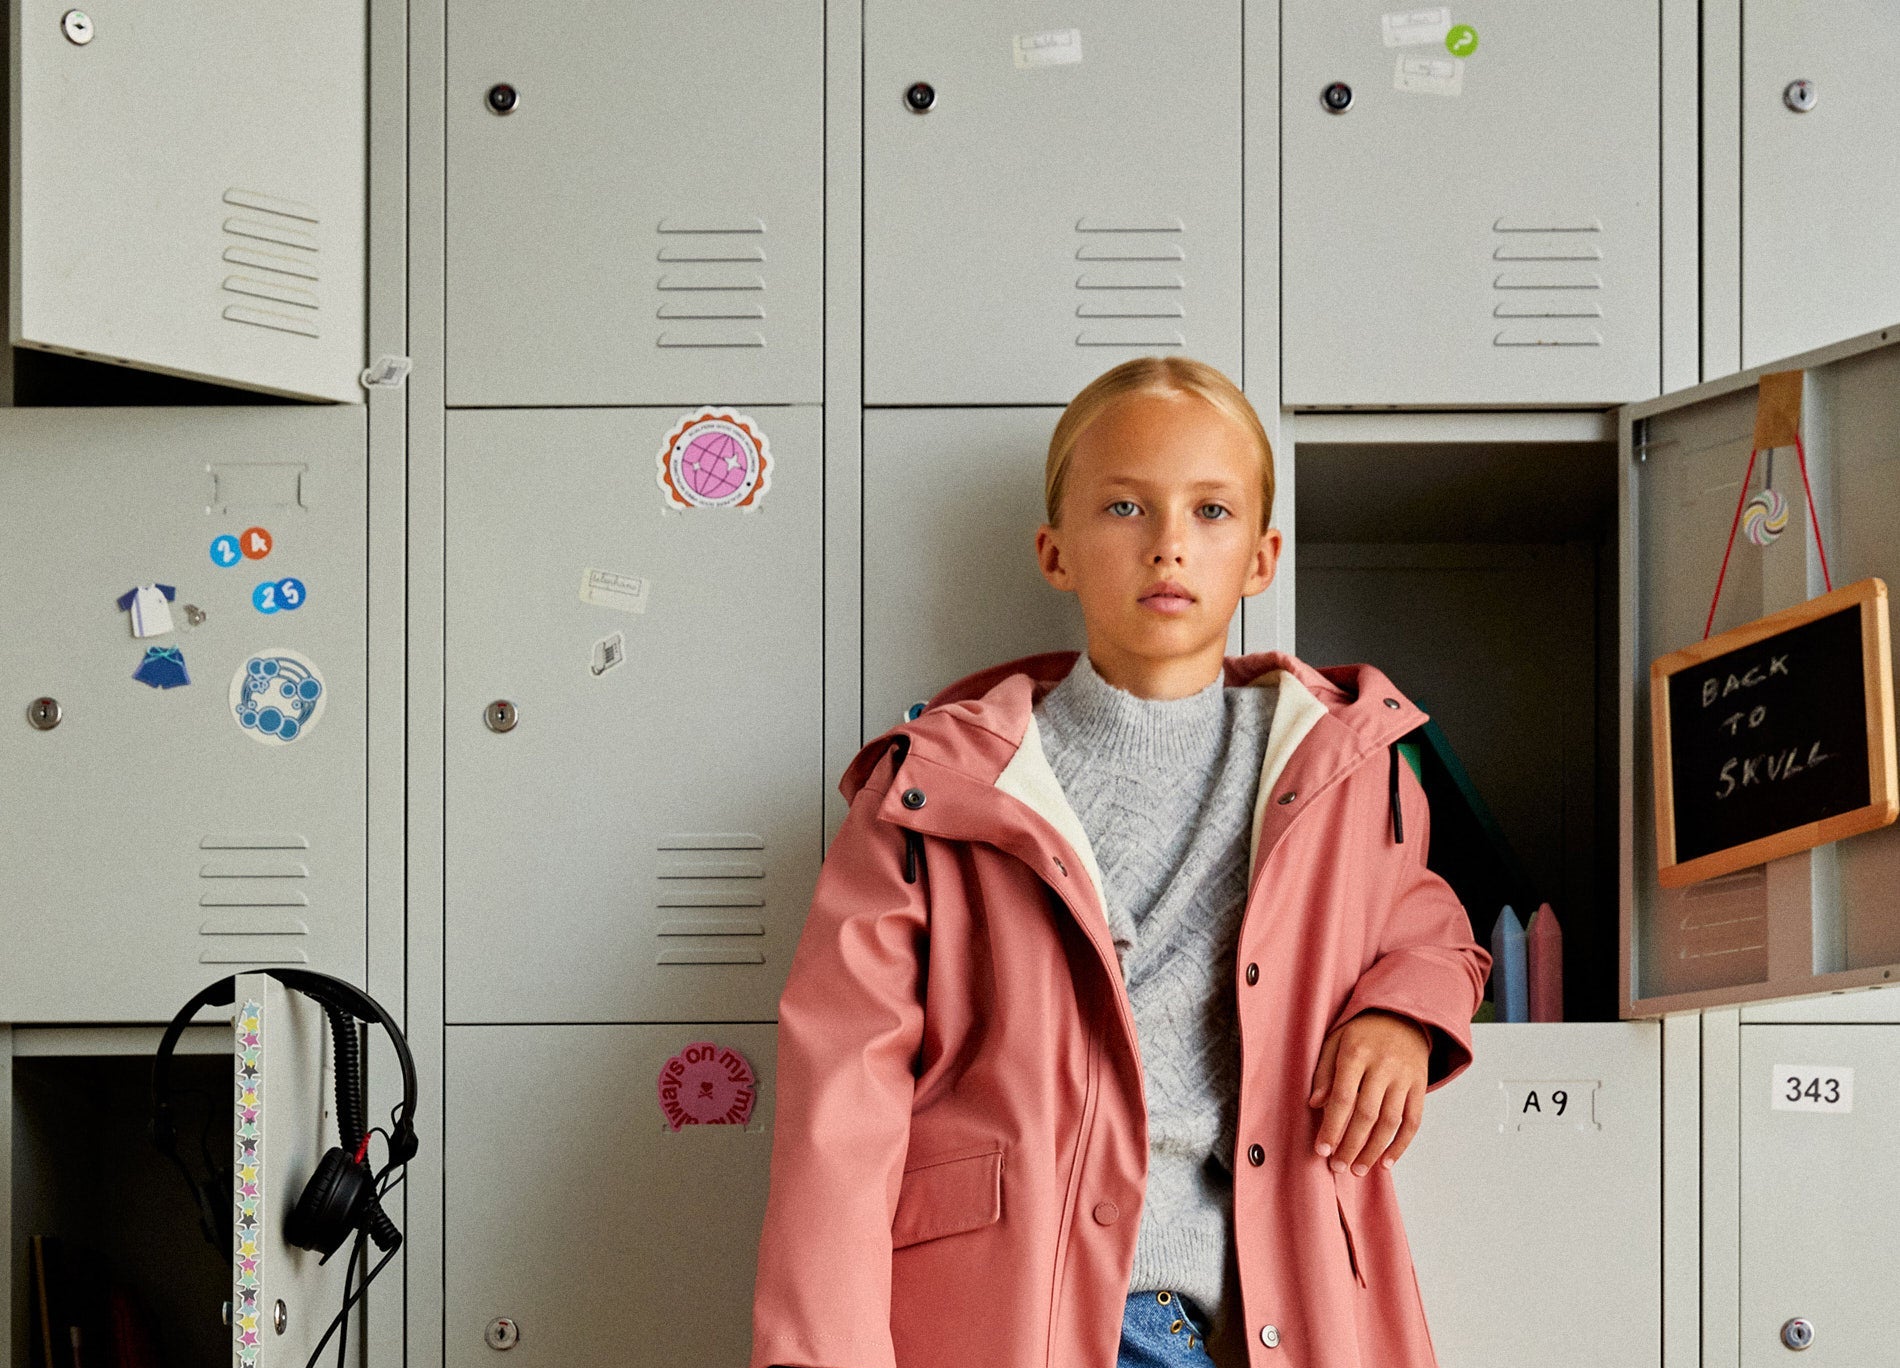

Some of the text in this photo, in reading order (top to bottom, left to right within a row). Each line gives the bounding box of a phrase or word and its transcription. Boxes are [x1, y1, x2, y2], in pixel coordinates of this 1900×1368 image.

[1702, 654, 1789, 708] BACK
[1720, 705, 1767, 736] TO
[685, 1046, 715, 1064] on
[719, 1051, 749, 1083] my
[1786, 1077, 1840, 1103] 343
